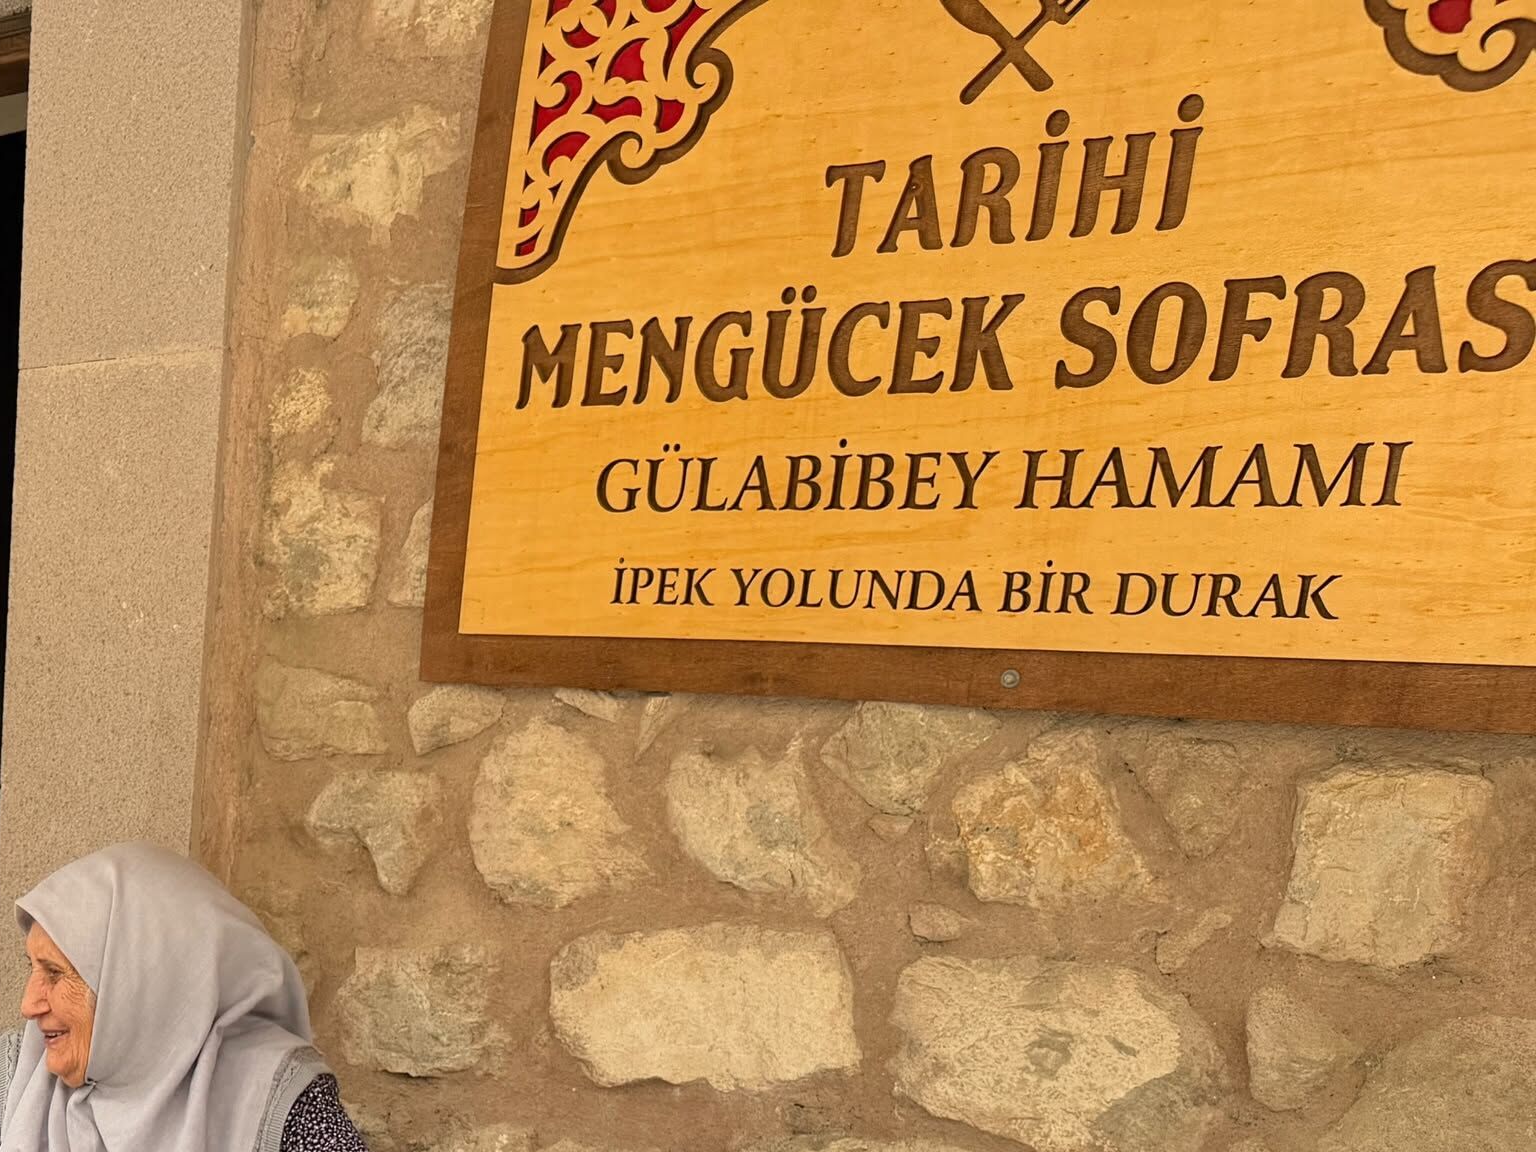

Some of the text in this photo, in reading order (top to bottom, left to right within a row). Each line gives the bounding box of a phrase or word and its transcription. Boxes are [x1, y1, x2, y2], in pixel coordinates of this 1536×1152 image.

[825, 94, 1205, 258] TARİHİ
[516, 286, 1026, 410] MENGÜCEK
[595, 438, 1414, 513] GÜLABİBEY HAMAMI
[609, 556, 1343, 621] İPEK YOLUNDA BİR DURAK
